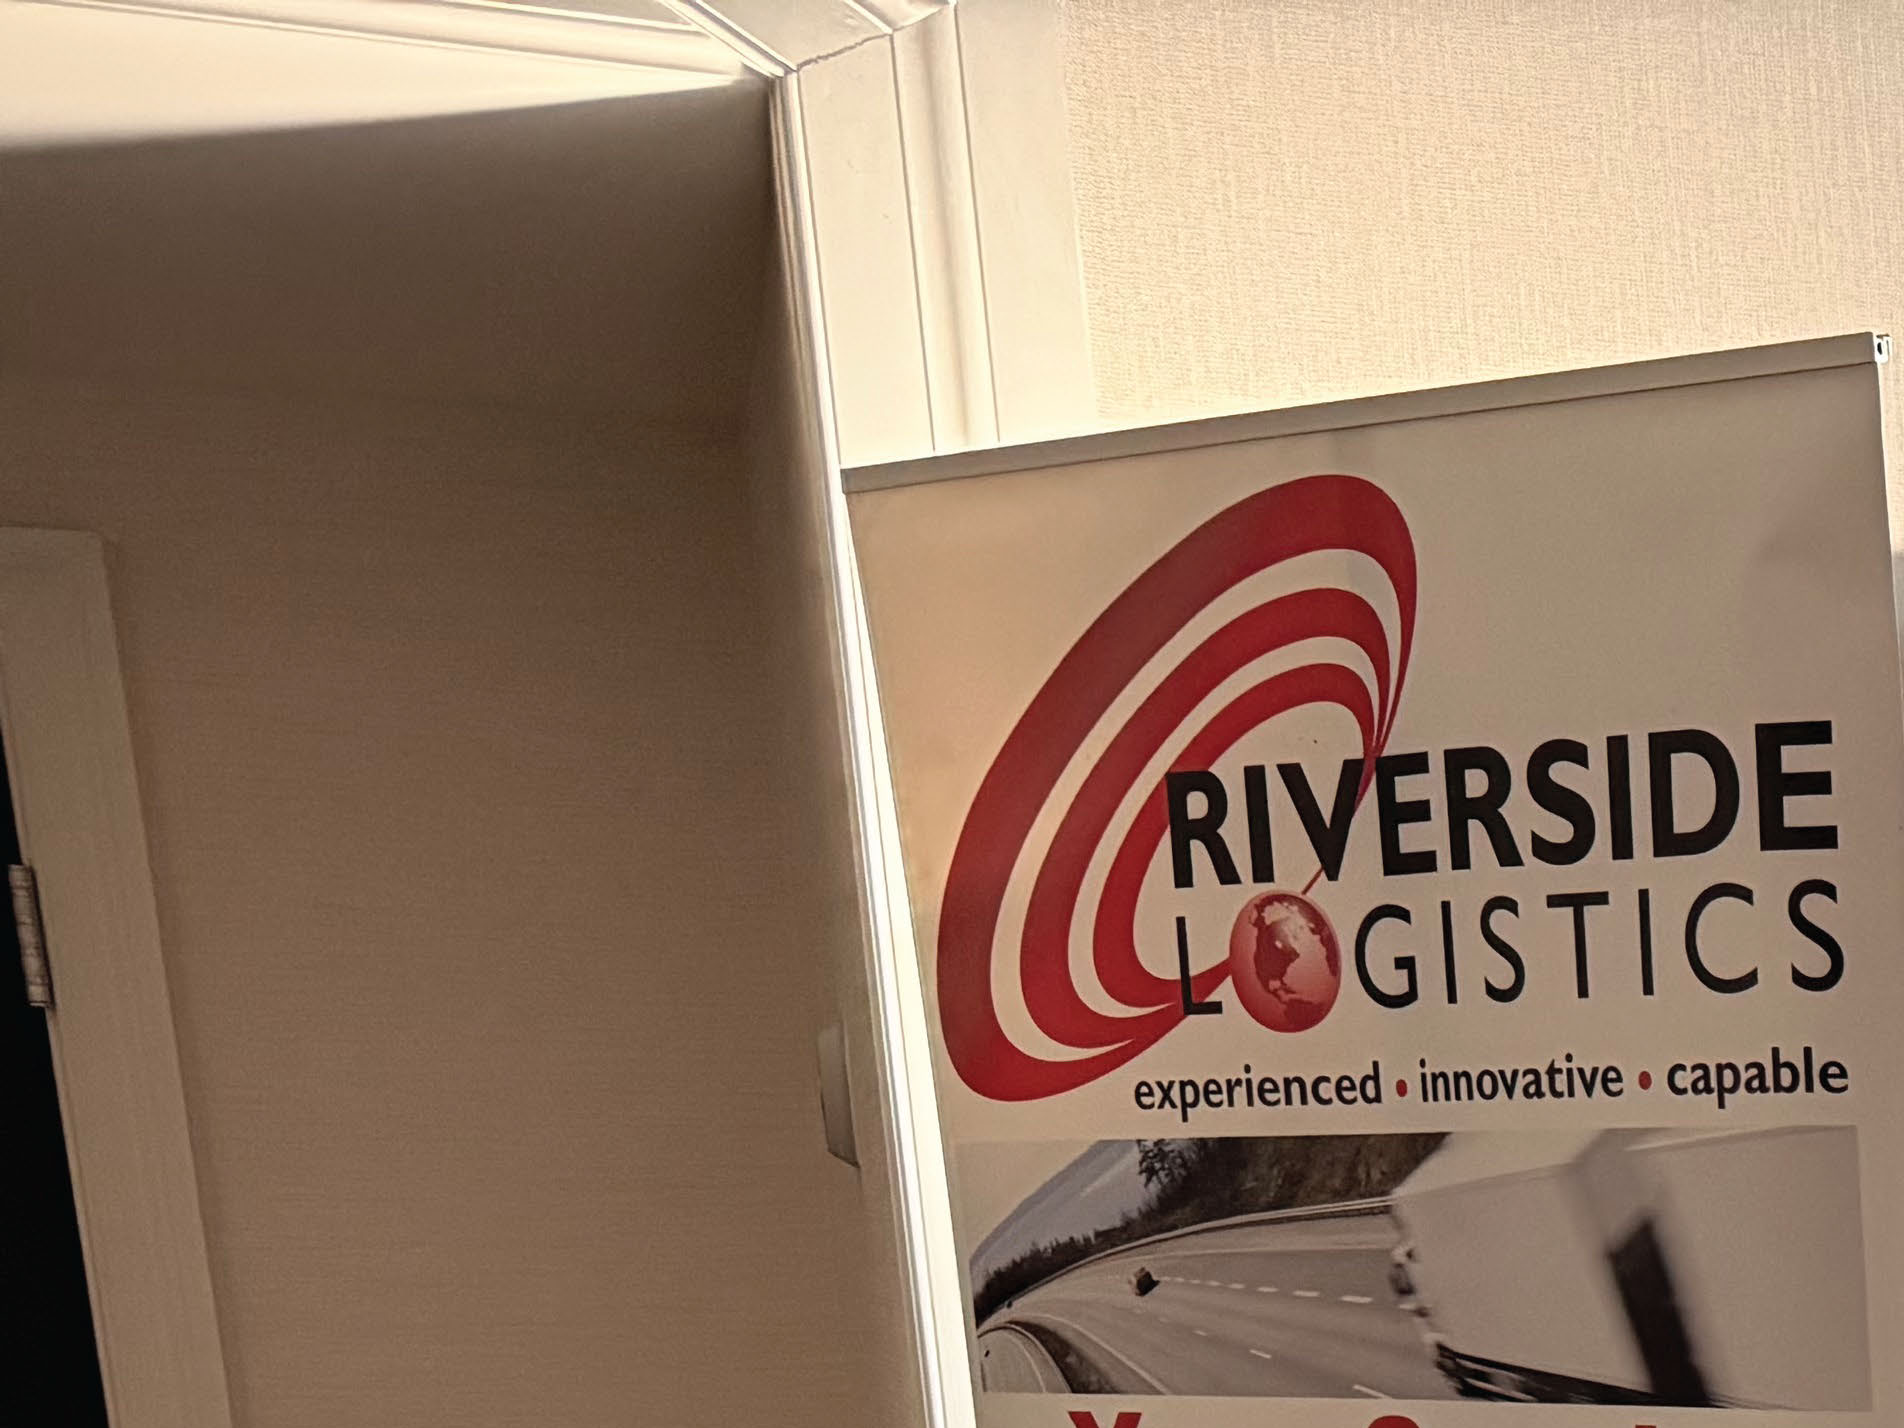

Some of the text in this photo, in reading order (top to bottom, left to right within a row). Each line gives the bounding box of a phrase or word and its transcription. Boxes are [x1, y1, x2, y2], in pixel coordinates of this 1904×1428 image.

[1165, 720, 1839, 889] RIVERSIDE
[1176, 879, 1845, 1032] LOGISTICS
[1133, 1046, 1849, 1122] experienced innovative capable
